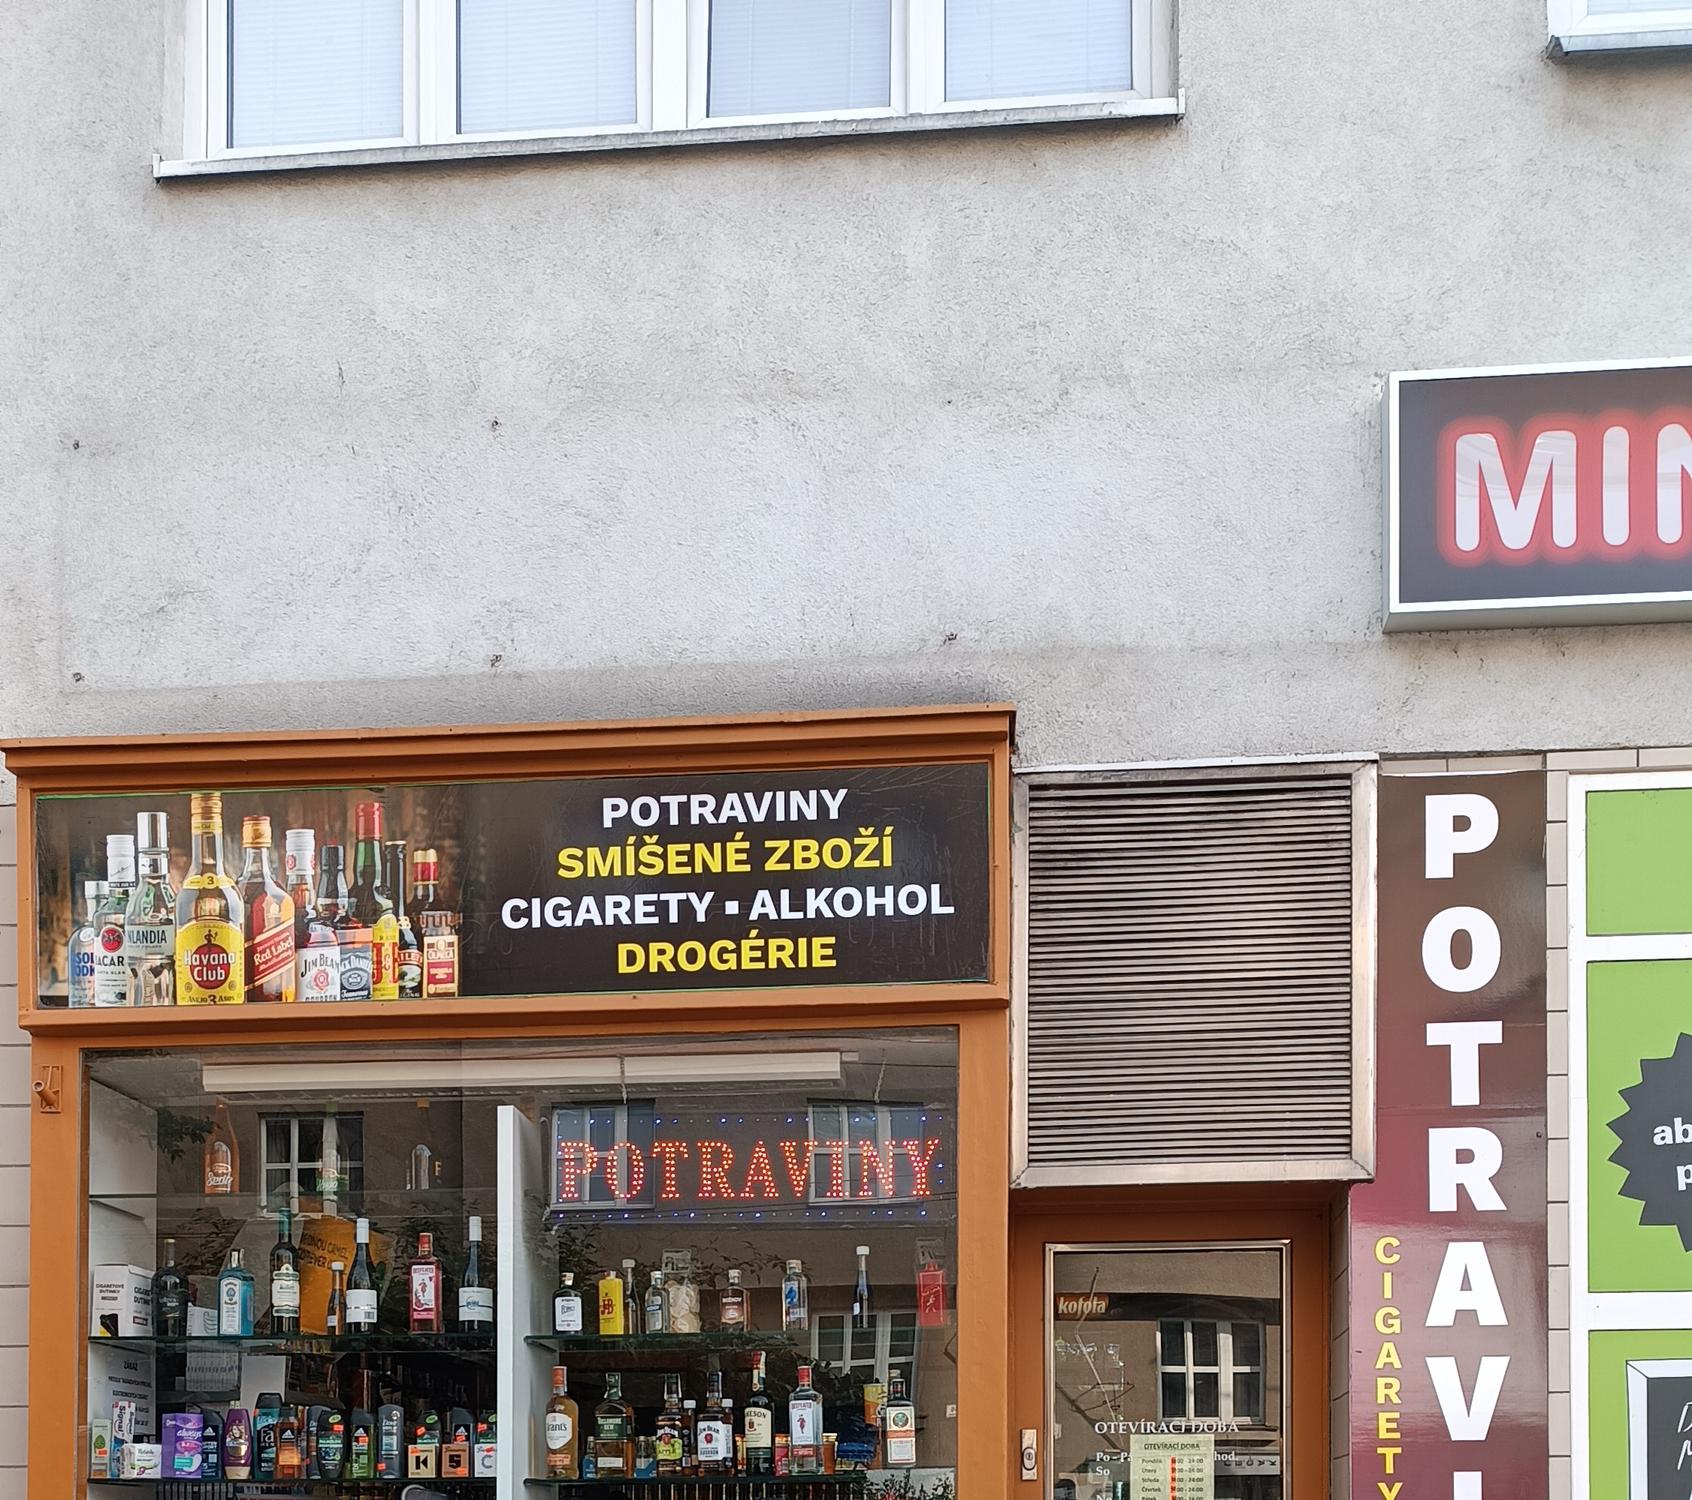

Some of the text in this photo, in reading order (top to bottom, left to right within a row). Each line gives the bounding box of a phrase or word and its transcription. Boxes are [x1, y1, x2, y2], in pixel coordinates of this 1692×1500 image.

[602, 788, 848, 828] POTRAVINY
[557, 826, 894, 878] SMÍŠENÉ ZBOŽÍ
[501, 891, 715, 929] CIGARETY
[749, 884, 954, 920] ALKOHOL
[184, 950, 236, 966] Havana
[253, 944, 271, 966] Red
[617, 929, 837, 973] DROGÉRIE
[193, 965, 225, 981] Club
[301, 958, 318, 978] JIM
[559, 1138, 940, 1199] POTRAVINY
[260, 1427, 274, 1443] Fa
[1094, 1418, 1240, 1434] OTEVÍRACÍ DOBA
[1096, 1452, 1111, 1462] Po
[1096, 1466, 1110, 1476] So
